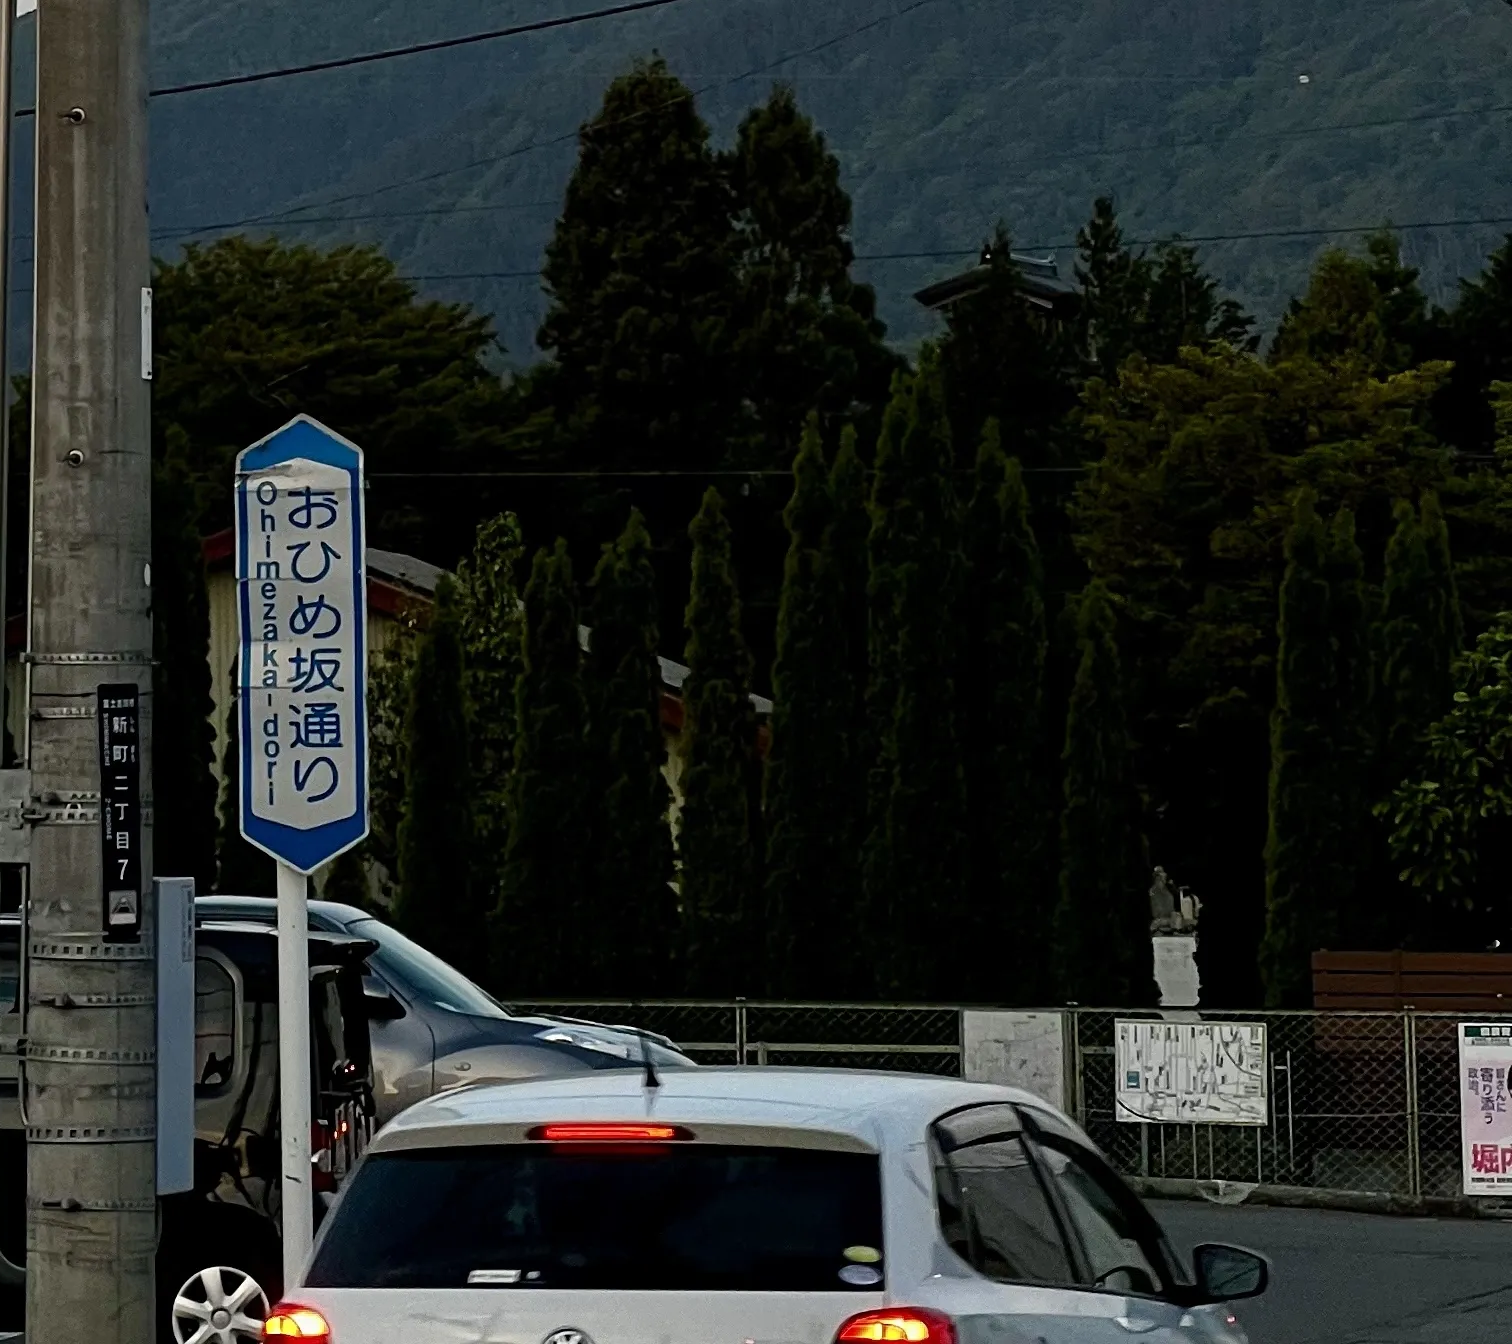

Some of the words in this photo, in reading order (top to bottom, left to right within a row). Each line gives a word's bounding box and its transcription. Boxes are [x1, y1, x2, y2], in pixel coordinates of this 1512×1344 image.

[255, 479, 281, 807] Ohimezaka-dori
[286, 485, 344, 804] おひめ坂通り
